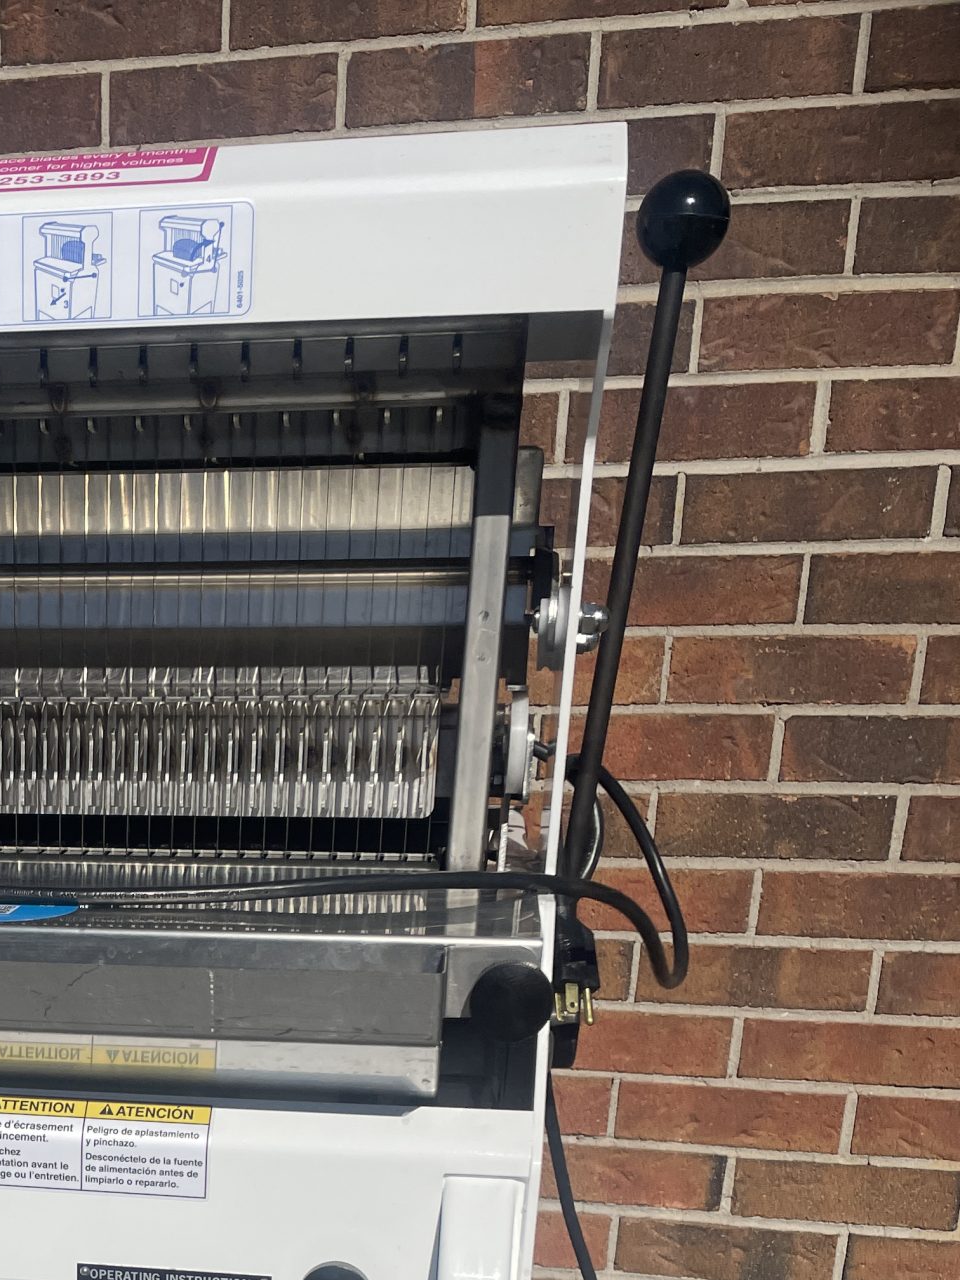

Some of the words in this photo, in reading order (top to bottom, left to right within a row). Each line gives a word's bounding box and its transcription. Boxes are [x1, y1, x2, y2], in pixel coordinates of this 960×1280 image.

[83, 152, 124, 160] every
[140, 149, 197, 157] months
[46, 162, 68, 171] for
[70, 160, 118, 170] higher
[121, 157, 184, 167] volumes
[204, 253, 212, 265] 4
[63, 299, 70, 310] 3
[115, 1104, 194, 1120] ATENCIÓN
[4, 1120, 73, 1131] d'écrasement
[87, 1125, 118, 1137] Peligro
[121, 1127, 132, 1136] de
[134, 1127, 199, 1141] aplastamiento
[85, 1138, 90, 1147] y
[31, 1160, 56, 1170] avant
[60, 1161, 68, 1170] le
[85, 1153, 147, 1164] Desconéctelo
[148, 1156, 161, 1165] de
[162, 1156, 171, 1165] la
[173, 1157, 204, 1167] fuente
[85, 1163, 96, 1173] de
[98, 1164, 156, 1176] alimentación
[159, 1167, 183, 1177] antes
[186, 1169, 198, 1178] de
[84, 1175, 124, 1187] limpiarlo
